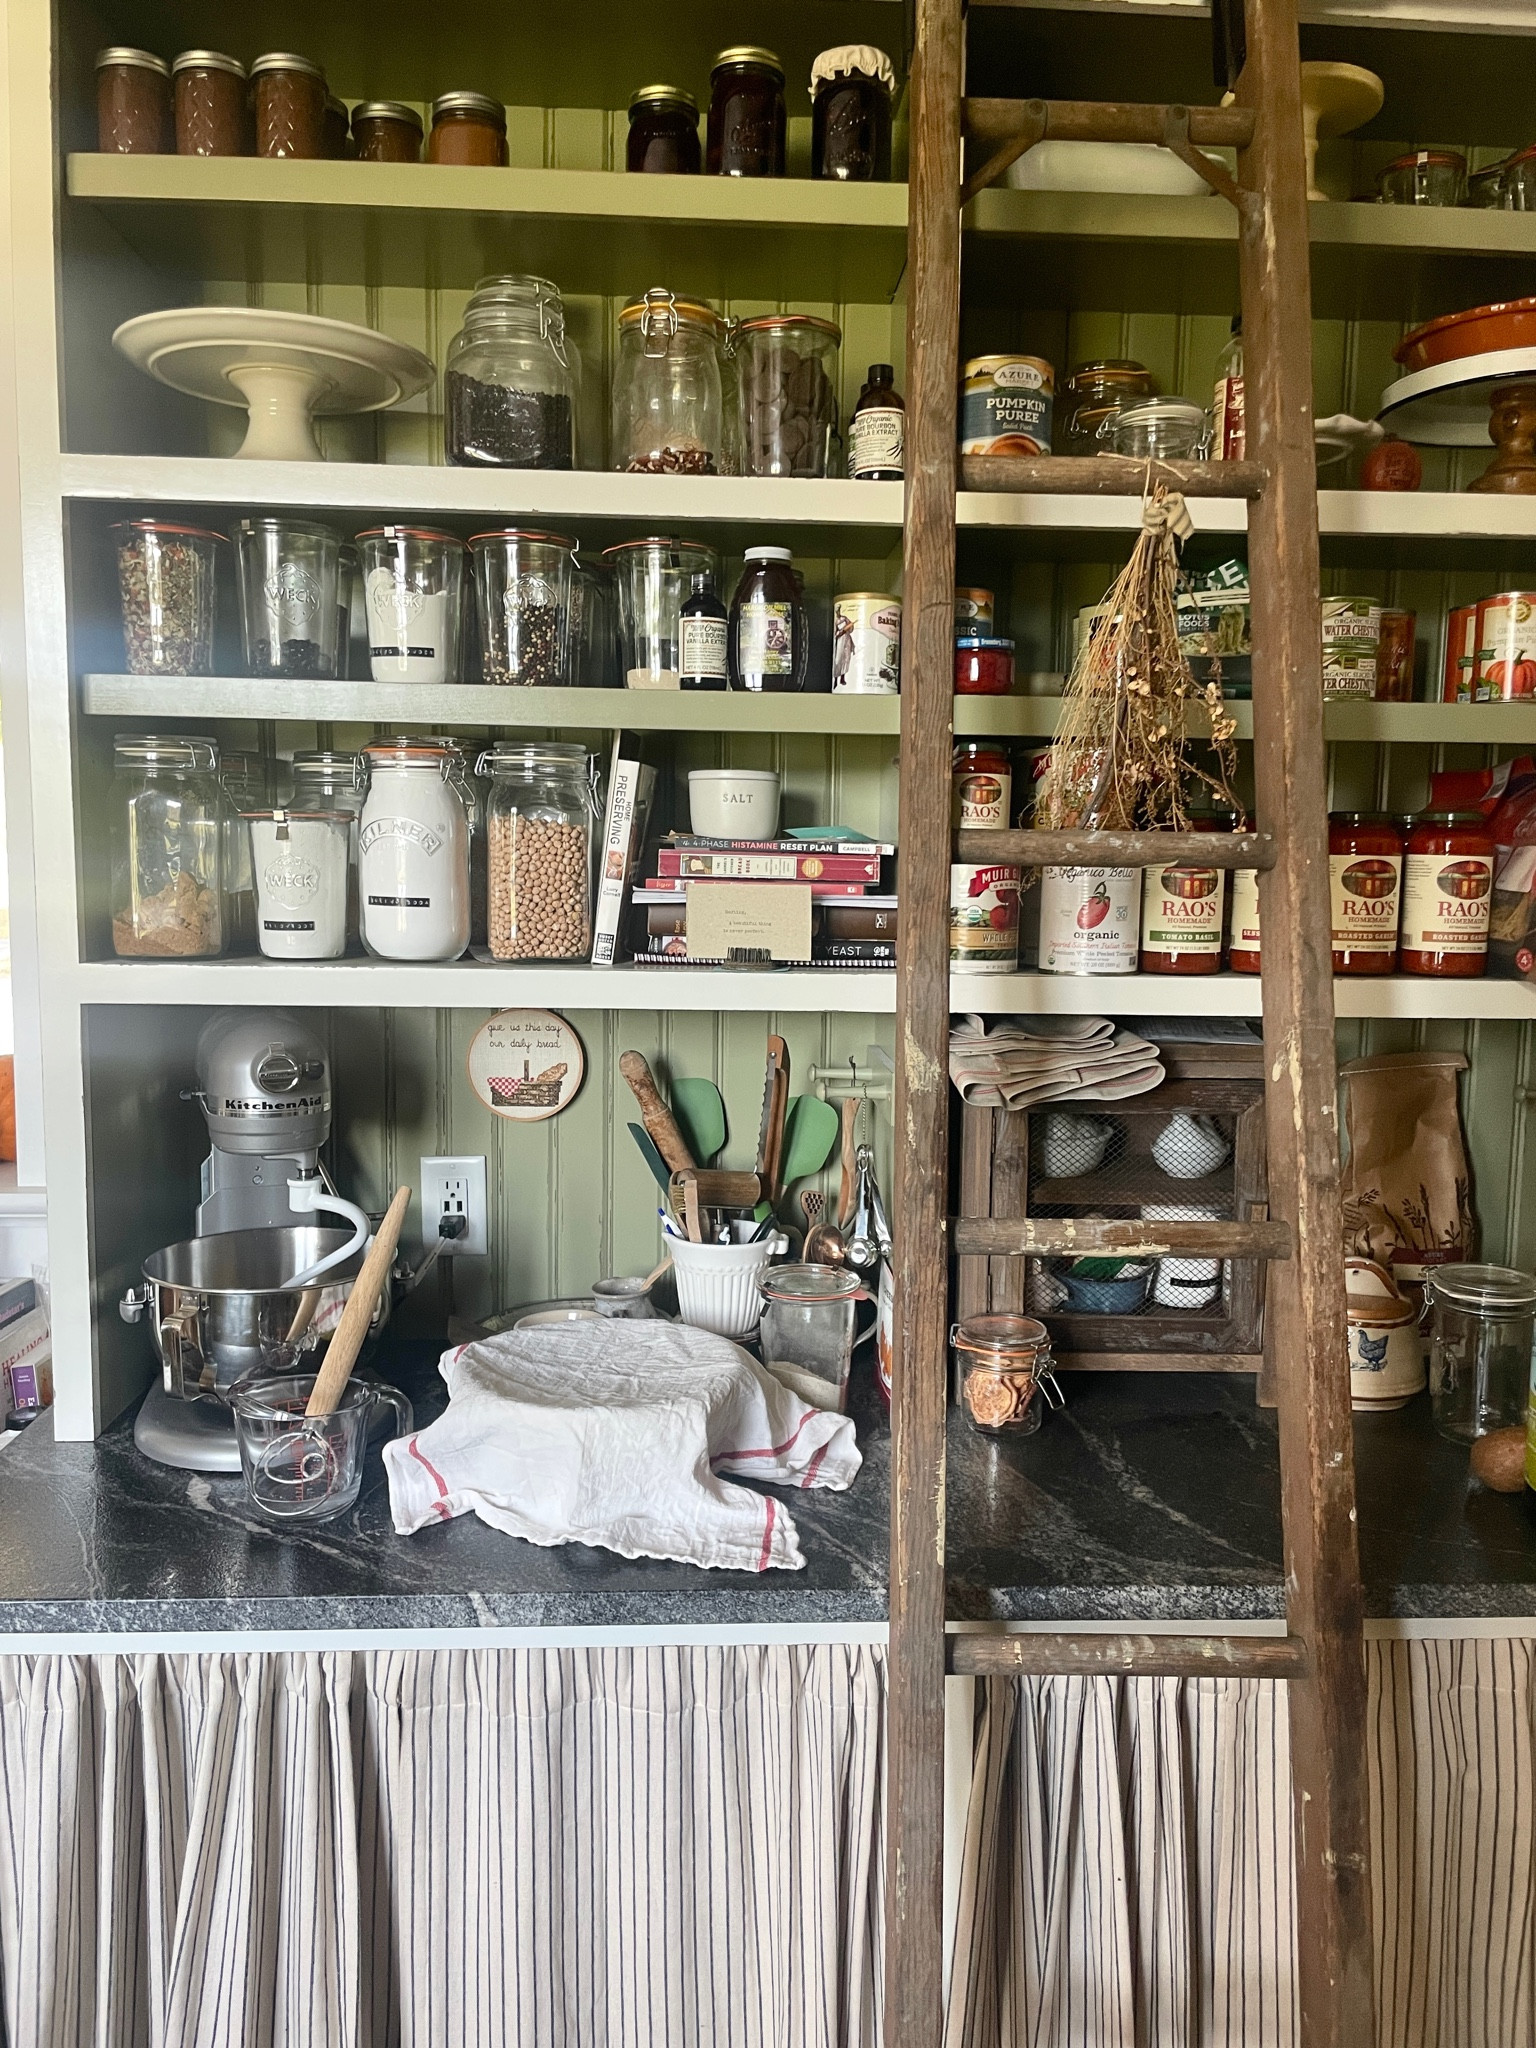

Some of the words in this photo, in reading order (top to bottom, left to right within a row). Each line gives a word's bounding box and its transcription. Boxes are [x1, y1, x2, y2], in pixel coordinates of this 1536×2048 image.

[998, 371, 1039, 381] AZURE
[986, 397, 1046, 413] PUMPKIN
[995, 410, 1039, 424] PUREE
[871, 429, 899, 437] EXTRACT
[269, 587, 316, 603] WECK
[1324, 625, 1351, 637] WATER
[722, 793, 753, 804] SALT
[610, 774, 629, 845] PRESERVING
[623, 801, 632, 821] HOME
[961, 806, 1000, 818] RAO'S
[731, 842, 778, 850] HISTAMINE
[780, 842, 808, 850] RESET
[809, 843, 833, 852] PLAN
[269, 874, 313, 888] WECK
[982, 868, 1010, 884] MUIR
[1161, 900, 1217, 917] RAO'S
[1342, 900, 1395, 916] RAO'S
[1437, 901, 1489, 917] RAO'S
[1073, 930, 1120, 941] organic
[825, 946, 862, 956] YEAST
[487, 1023, 506, 1038] give
[510, 1024, 521, 1032] us
[525, 1023, 542, 1032] this
[544, 1022, 563, 1038] day
[490, 1040, 506, 1049] our
[510, 1038, 532, 1054] daily
[536, 1038, 561, 1049] bread
[225, 1096, 323, 1111] KitchenAid
